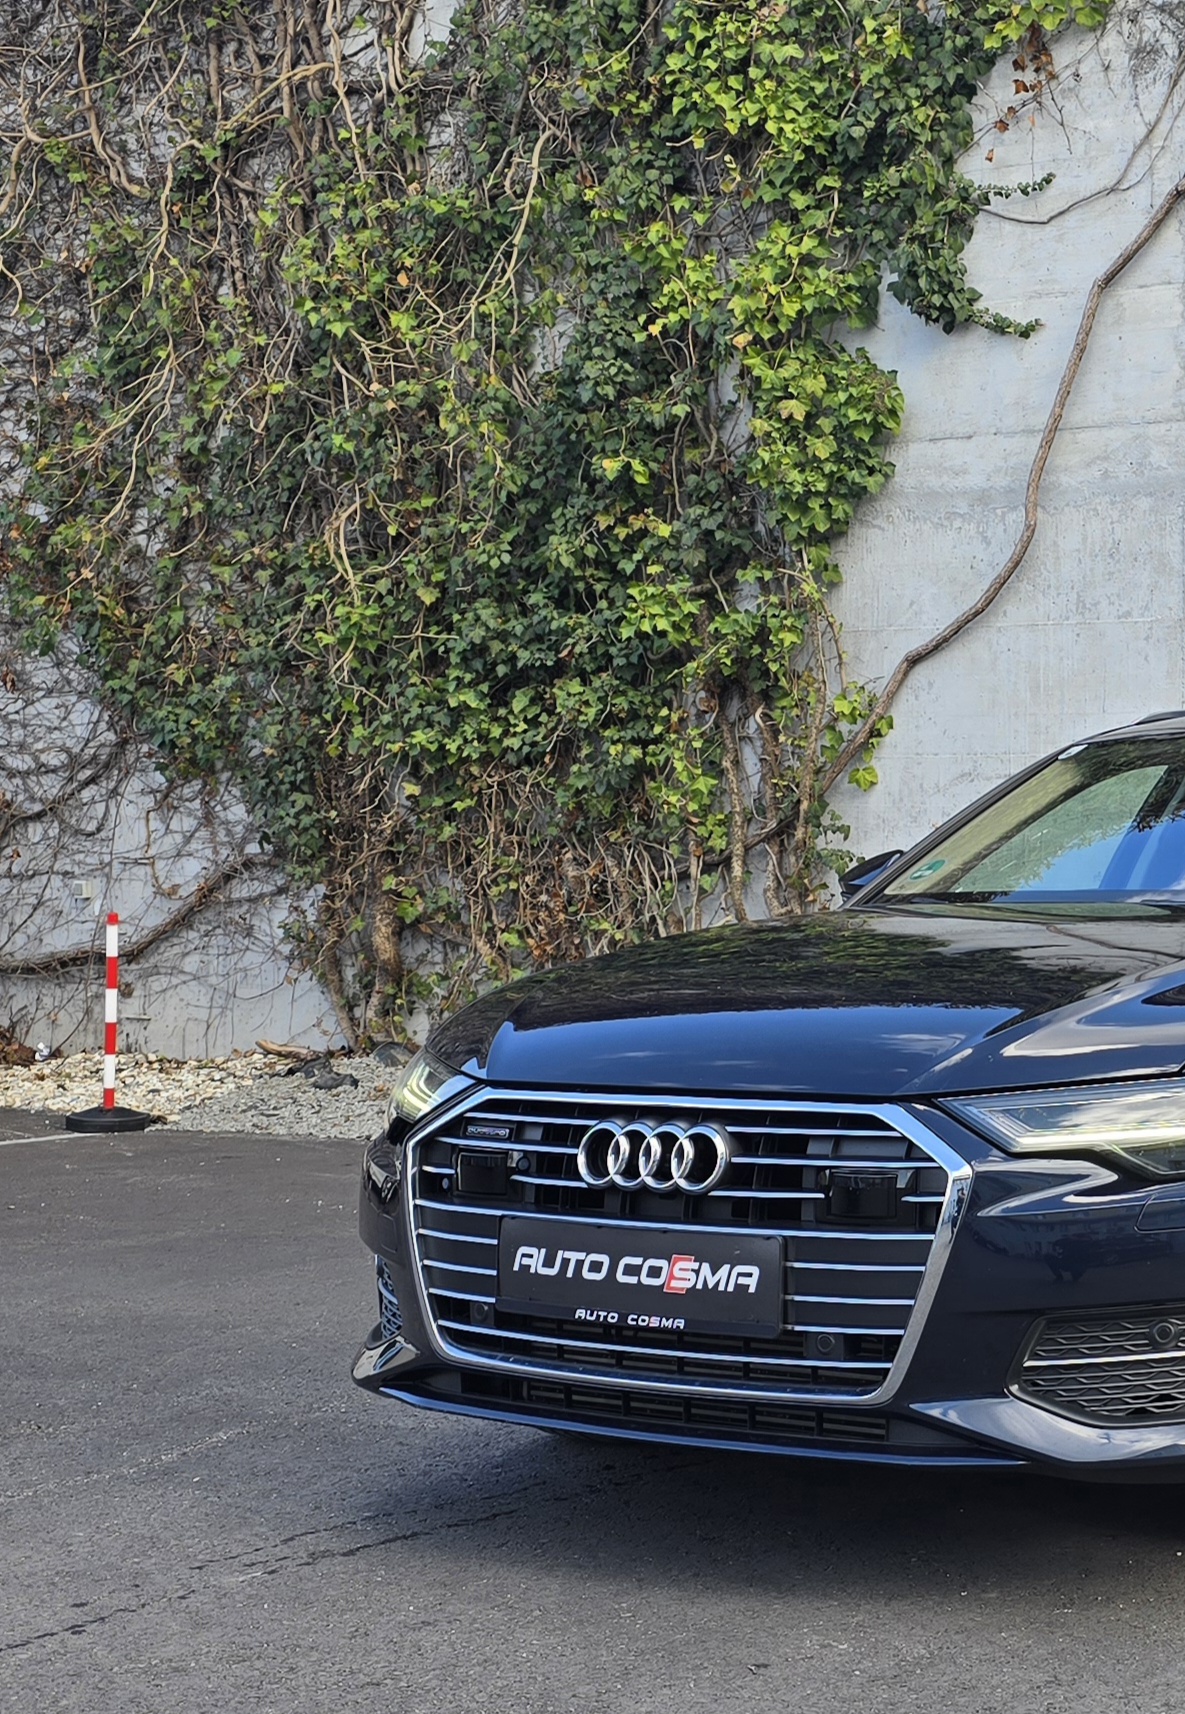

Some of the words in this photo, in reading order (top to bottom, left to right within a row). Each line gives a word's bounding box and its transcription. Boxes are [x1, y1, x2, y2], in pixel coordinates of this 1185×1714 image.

[512, 1246, 610, 1281] AUTO
[615, 1254, 760, 1293] COSMA
[574, 1308, 619, 1323] AUTO
[626, 1313, 685, 1330] COSMA
